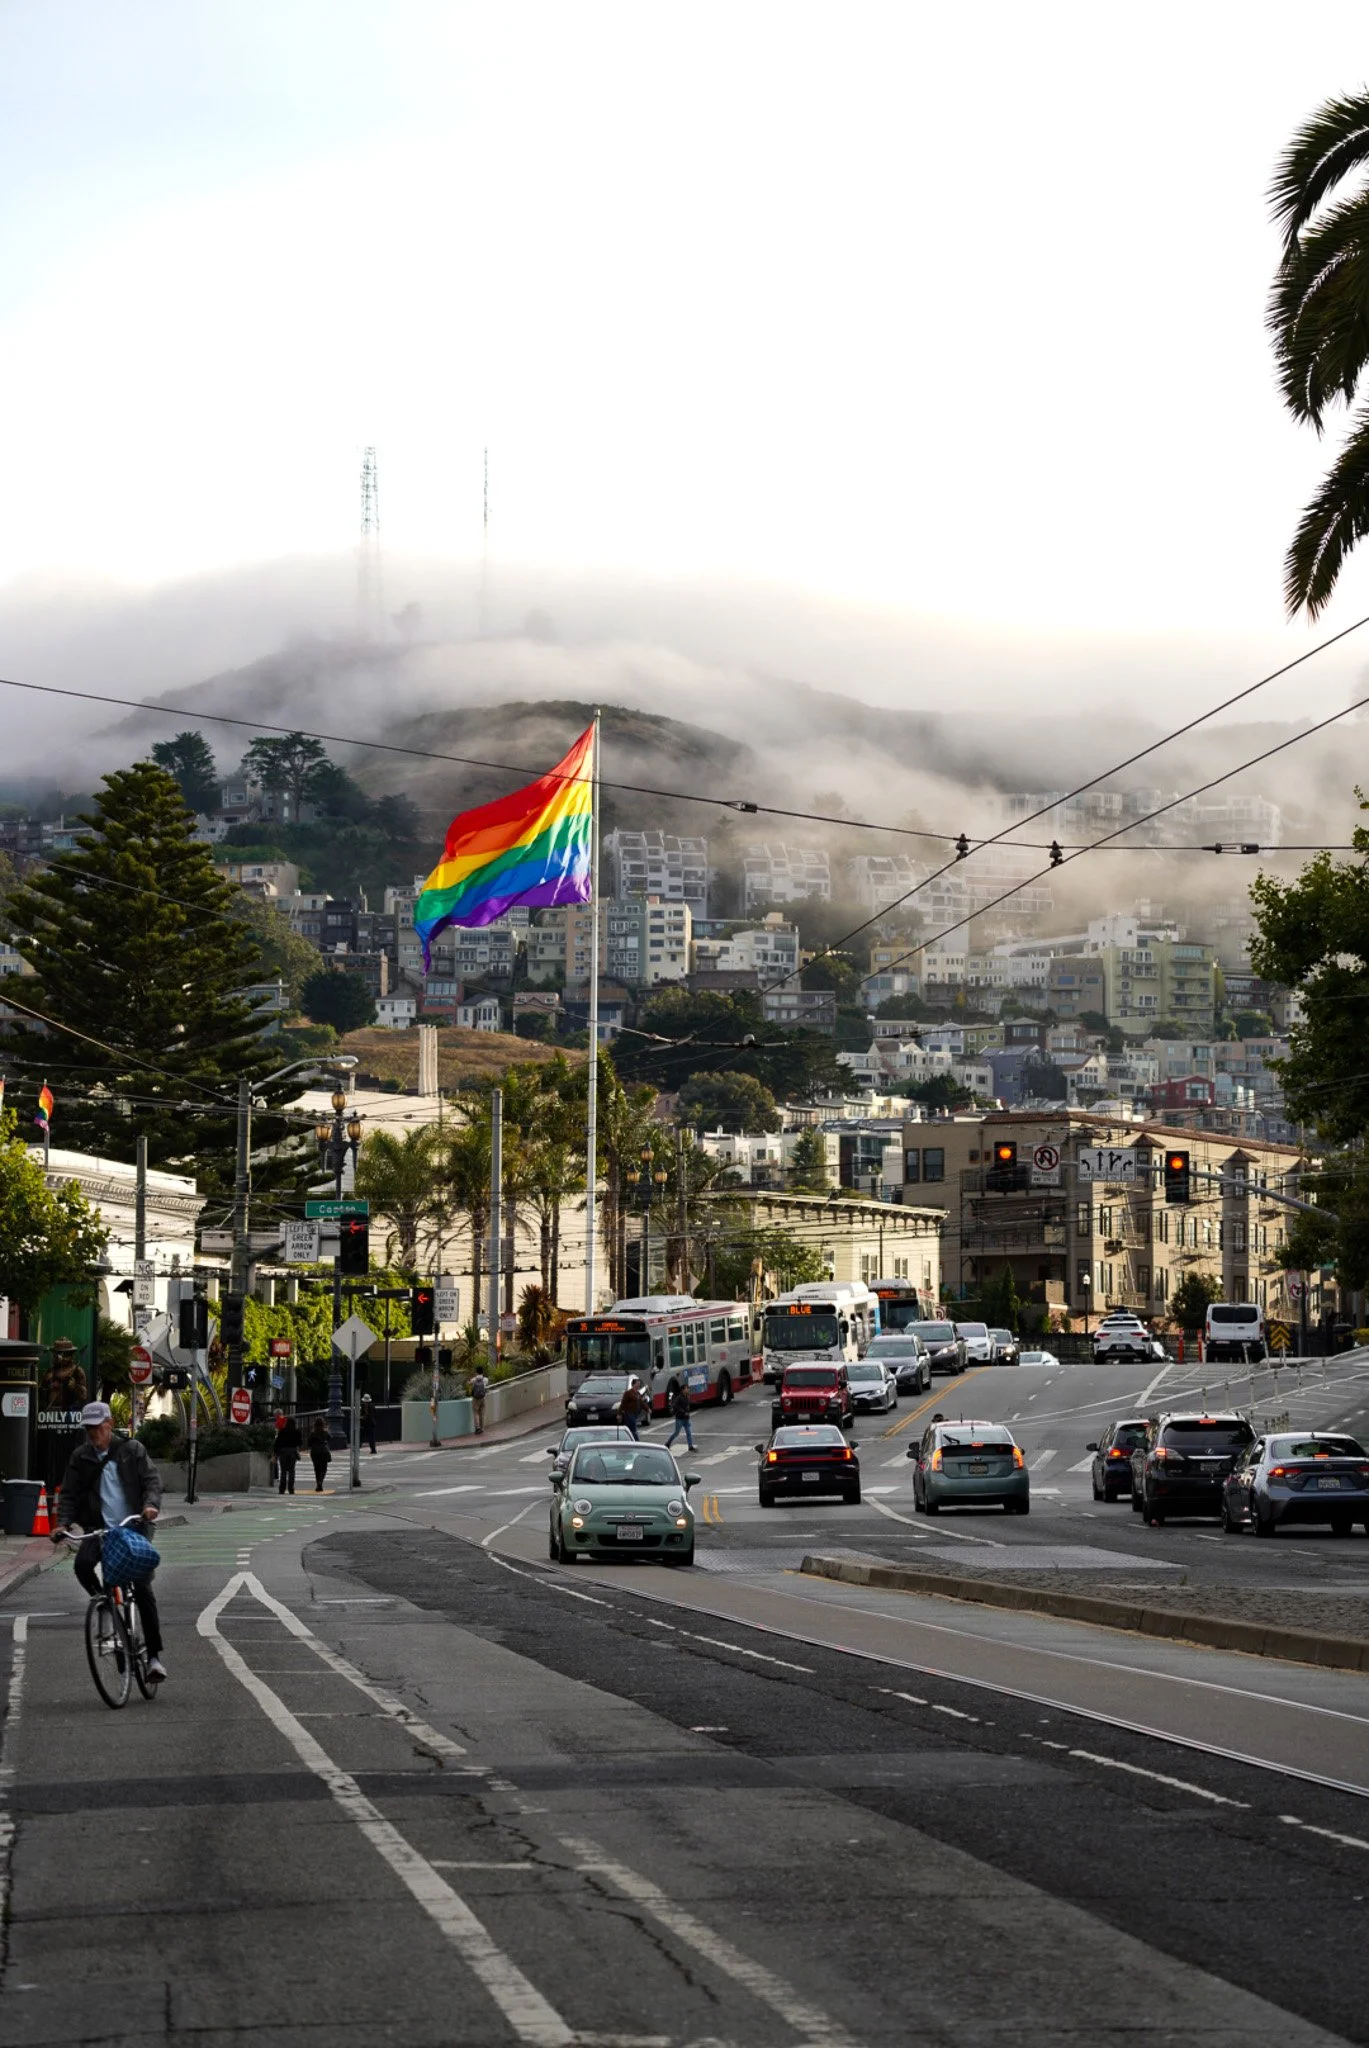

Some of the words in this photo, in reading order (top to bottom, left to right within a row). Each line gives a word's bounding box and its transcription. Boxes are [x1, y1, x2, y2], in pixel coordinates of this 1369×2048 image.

[290, 1225, 304, 1233] LEFT
[790, 1305, 812, 1315] BLUE
[38, 1411, 67, 1423] ONLY
[70, 1411, 82, 1423] YO
